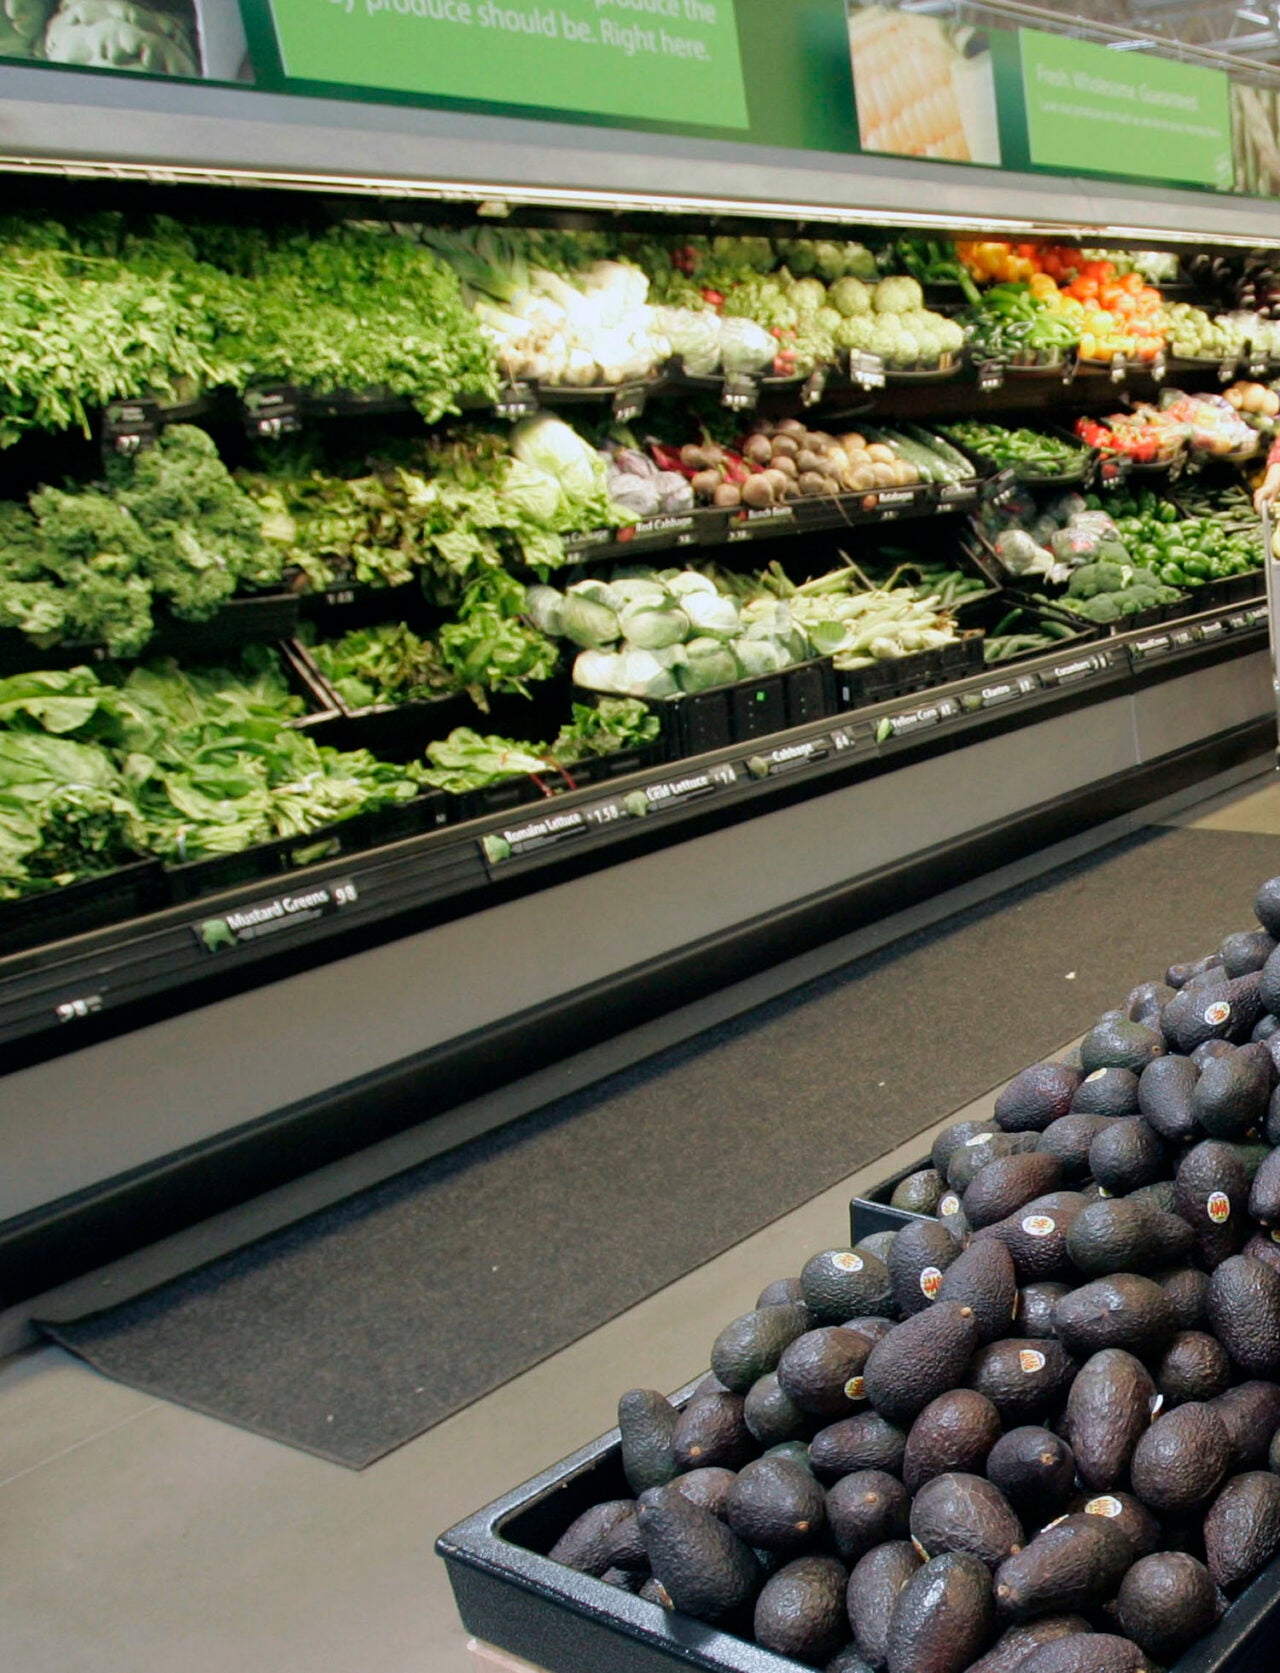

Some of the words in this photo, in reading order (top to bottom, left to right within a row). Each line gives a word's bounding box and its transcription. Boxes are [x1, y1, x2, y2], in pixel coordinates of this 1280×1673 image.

[683, 0, 716, 24] the
[476, 1, 557, 39] should
[561, 11, 597, 44] be.
[600, 17, 657, 57] Right
[659, 26, 711, 61] here.
[917, 706, 939, 723] Corn
[669, 775, 710, 797] Lettuce
[503, 819, 549, 845] Romaine
[545, 811, 583, 835] Lettuce
[225, 900, 285, 930] Mustard
[282, 888, 330, 915] Greens
